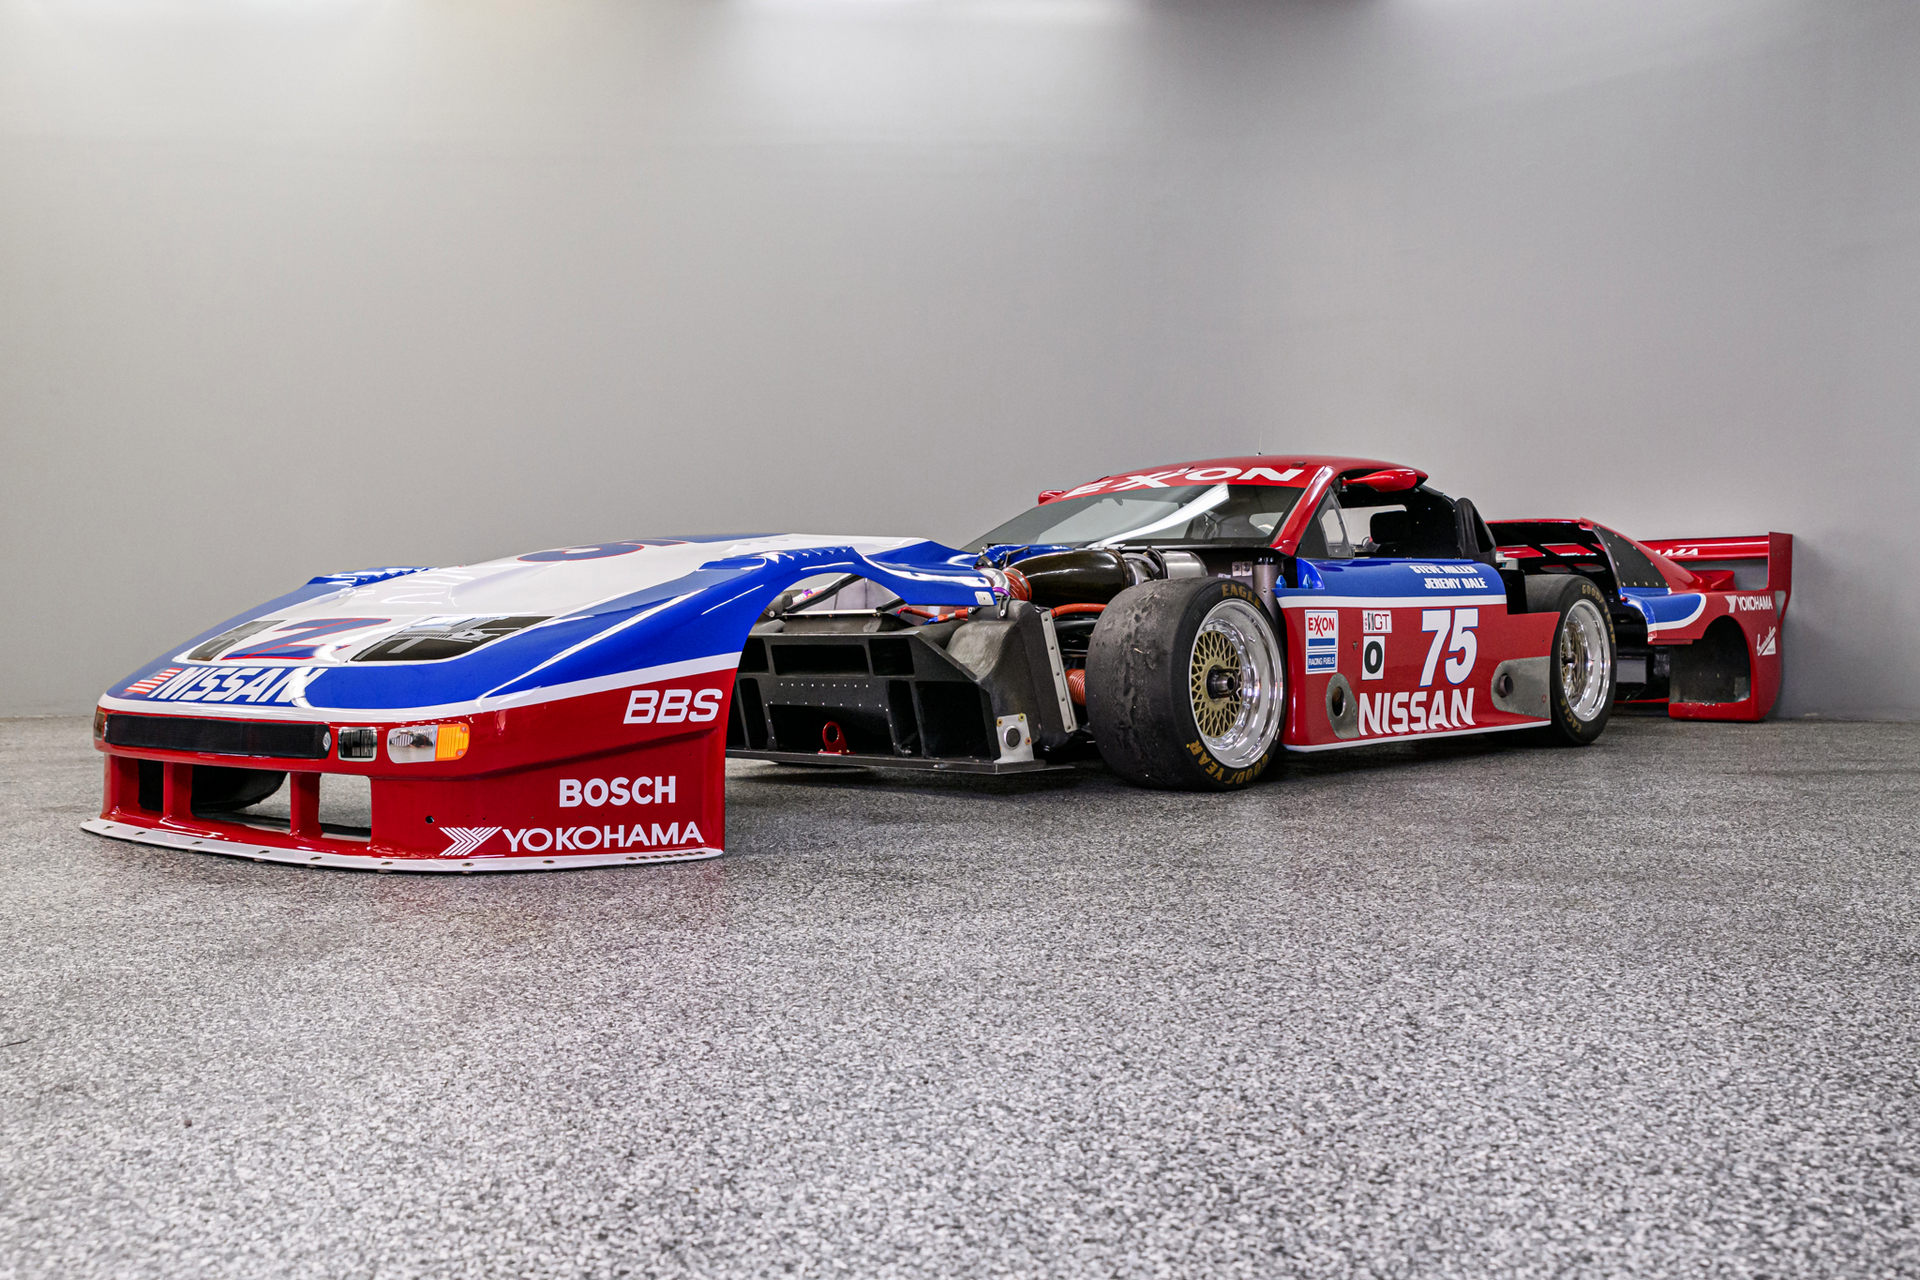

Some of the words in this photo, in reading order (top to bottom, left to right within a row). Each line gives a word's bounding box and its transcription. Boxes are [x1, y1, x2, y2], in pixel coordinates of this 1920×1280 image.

[1061, 467, 1304, 498] EXXON
[1409, 565, 1443, 574] STEVE
[1424, 577, 1461, 589] JEREMY
[1461, 577, 1488, 589] DALE
[1221, 583, 1261, 609] EAGLE
[1737, 595, 1773, 611] YOKOHAMA
[1308, 615, 1335, 637] EXXON
[1419, 606, 1479, 688] 75
[147, 666, 328, 703] NISSAN
[623, 688, 723, 724] BBS
[1358, 687, 1477, 736] NISSAN
[559, 775, 676, 808] BOSCH
[502, 821, 705, 852] YOKOHAMA
